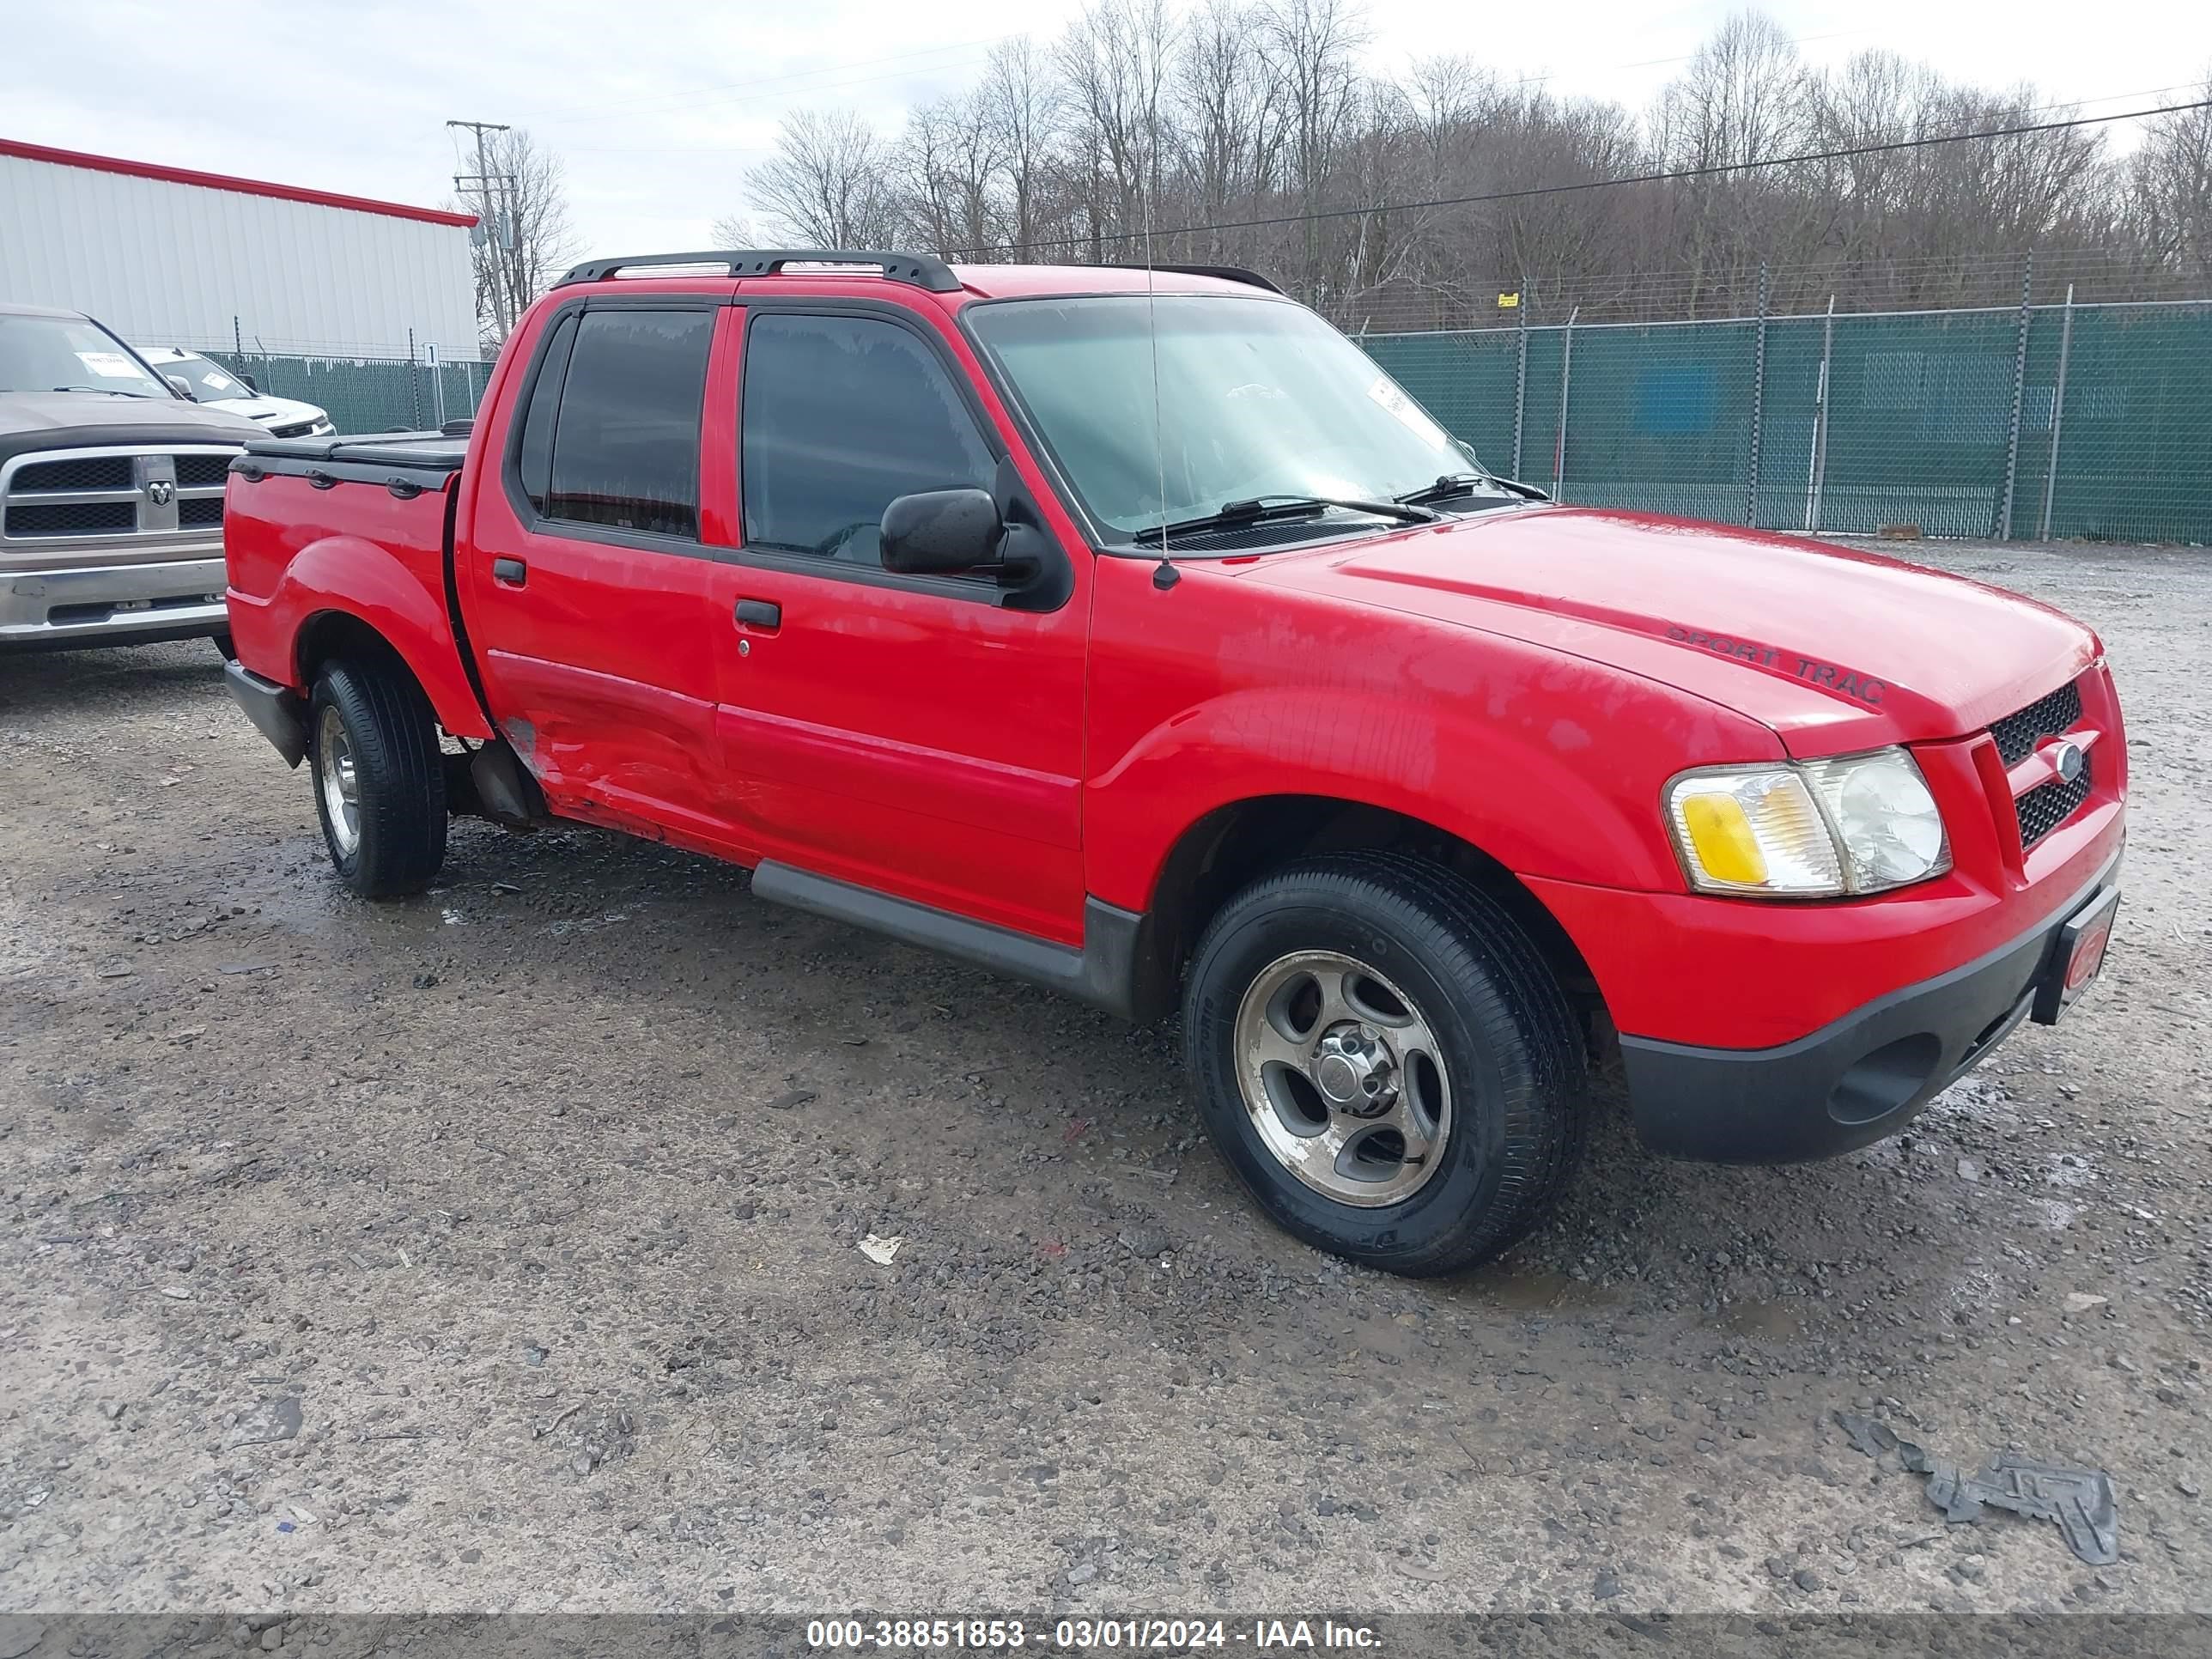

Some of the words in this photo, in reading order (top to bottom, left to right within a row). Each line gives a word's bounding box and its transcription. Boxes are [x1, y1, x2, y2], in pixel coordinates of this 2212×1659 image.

[428, 345, 434, 363] 1
[1665, 627, 1781, 666] SPORT
[1796, 659, 1886, 704] TRAC
